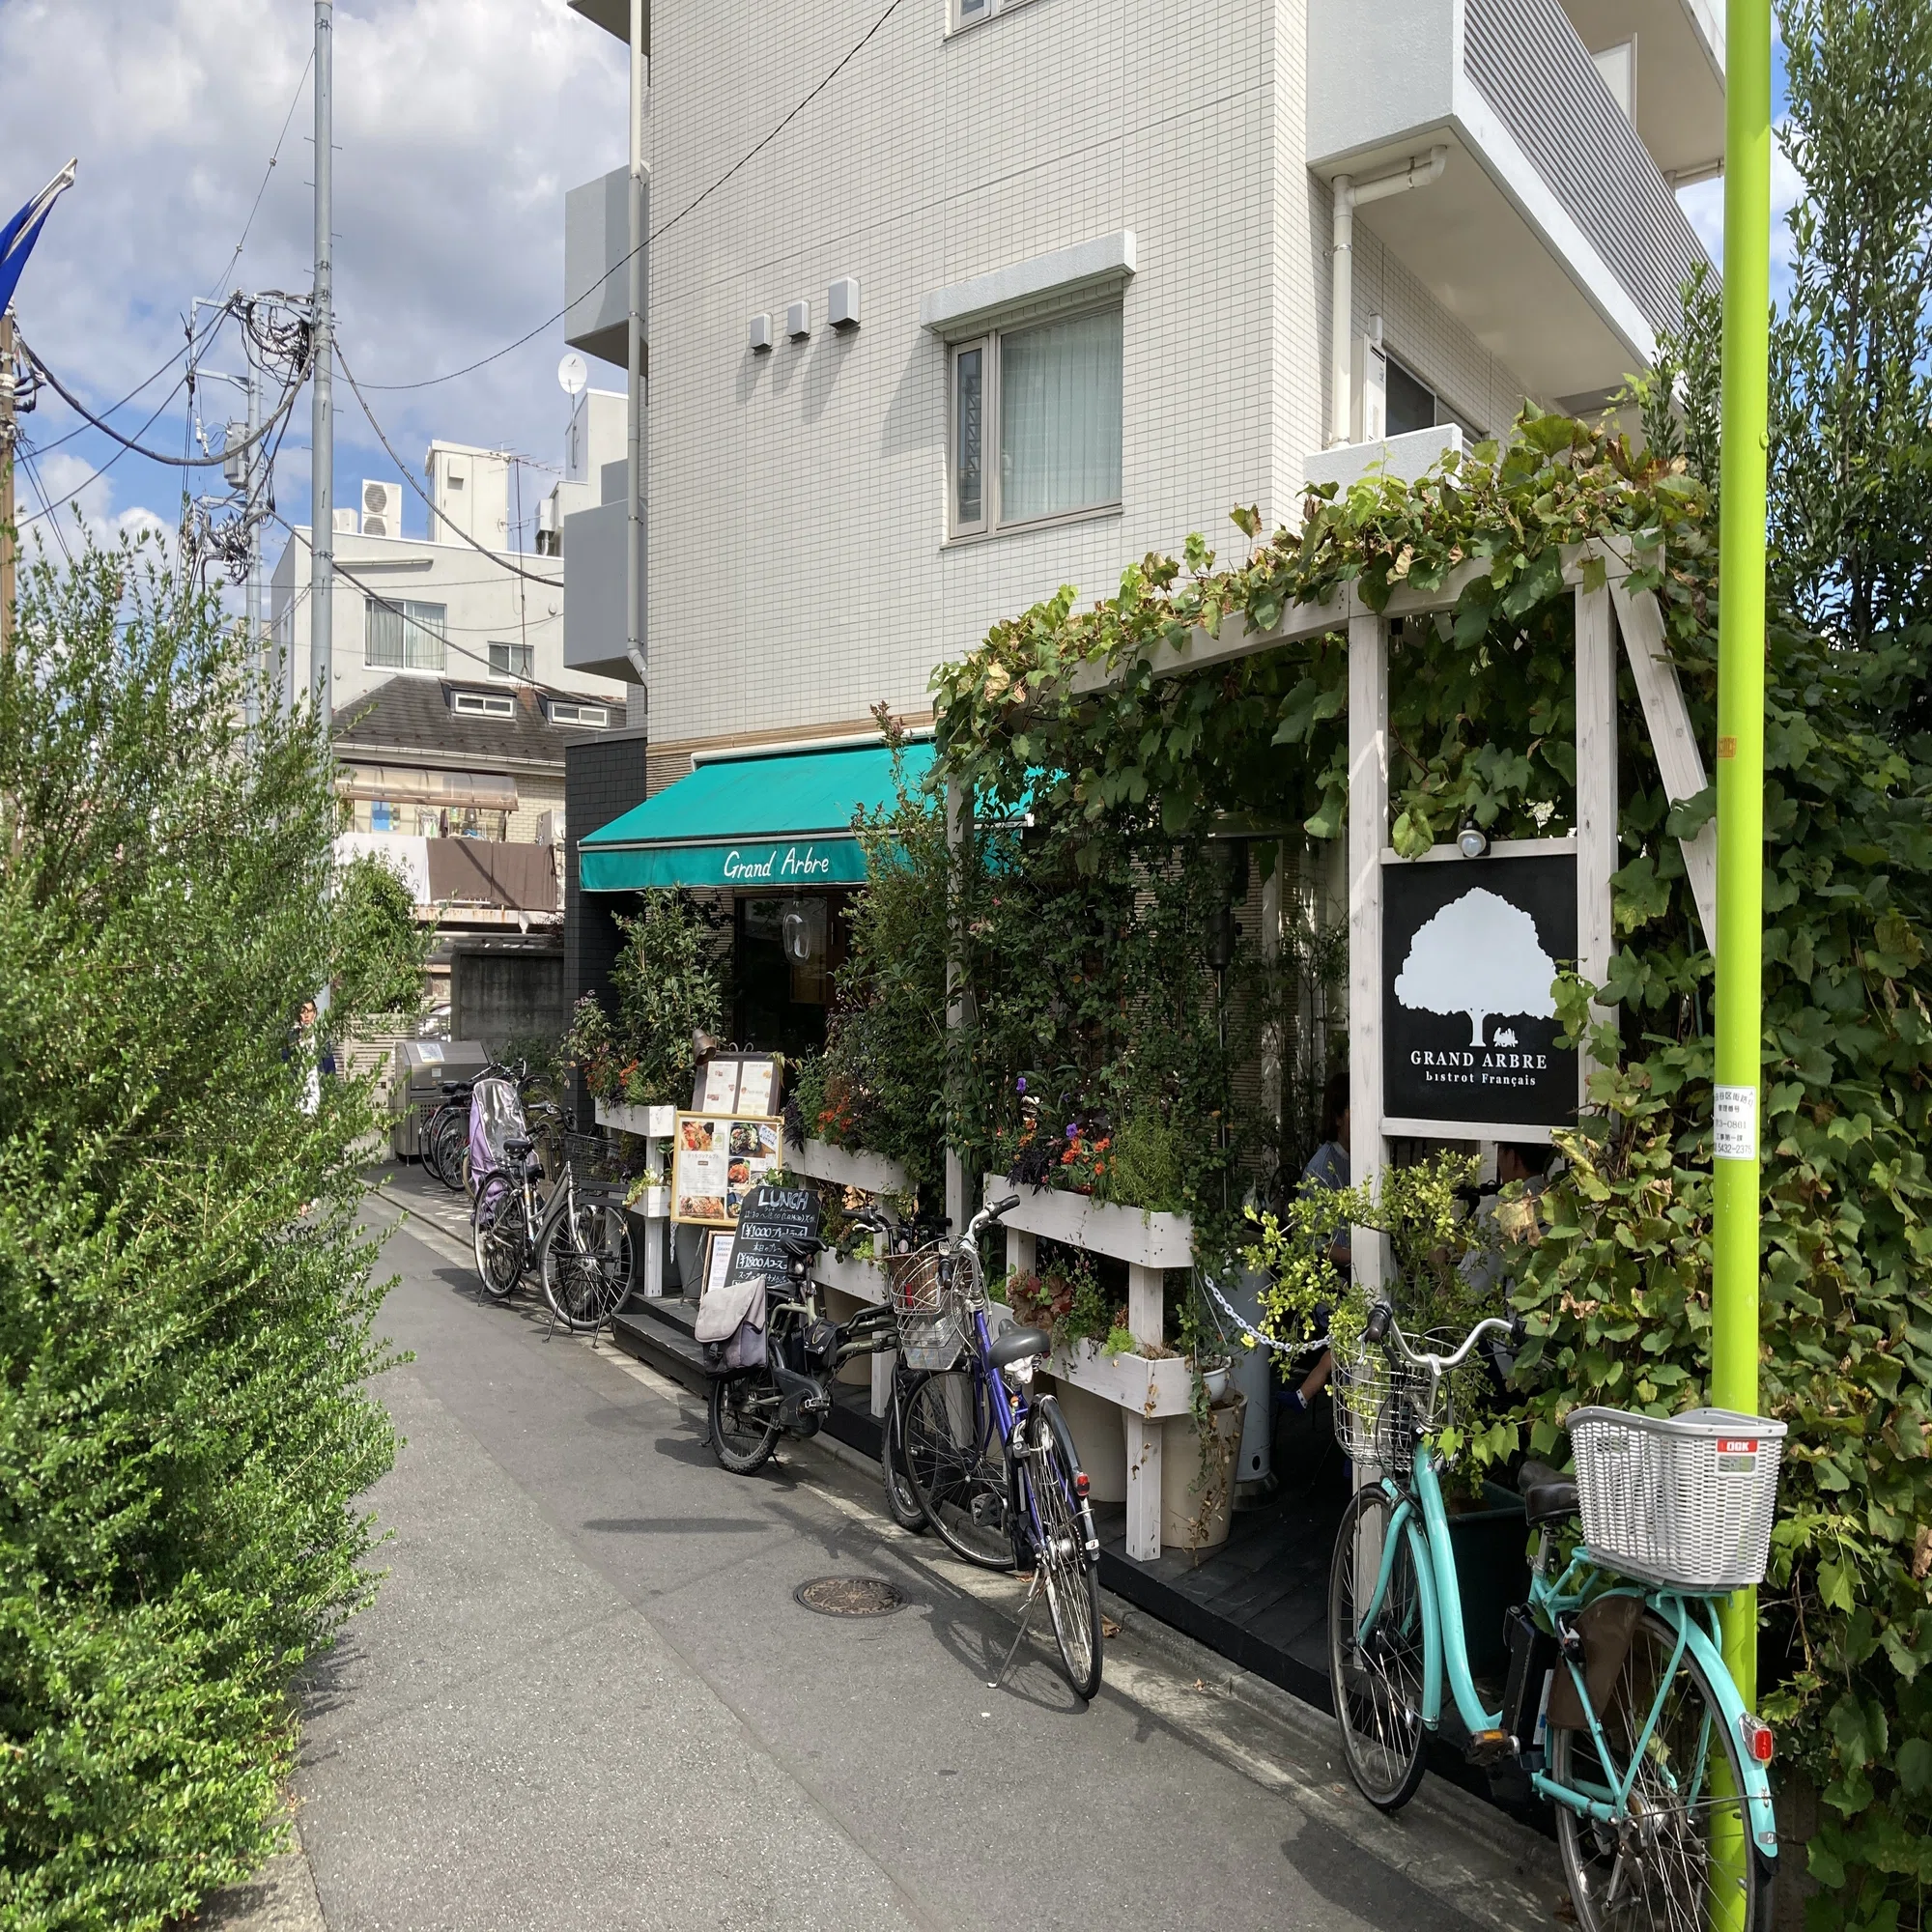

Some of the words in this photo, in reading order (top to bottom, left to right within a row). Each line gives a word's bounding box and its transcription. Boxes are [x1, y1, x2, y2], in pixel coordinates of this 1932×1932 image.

[724, 850, 777, 878] Grand
[781, 846, 829, 875] Arbre
[1410, 1050, 1474, 1066] GRAND
[1482, 1053, 1548, 1069] ARBRE
[1426, 1071, 1474, 1083] bistrot
[1482, 1073, 1536, 1087] Français
[758, 1188, 810, 1211] LUNCH
